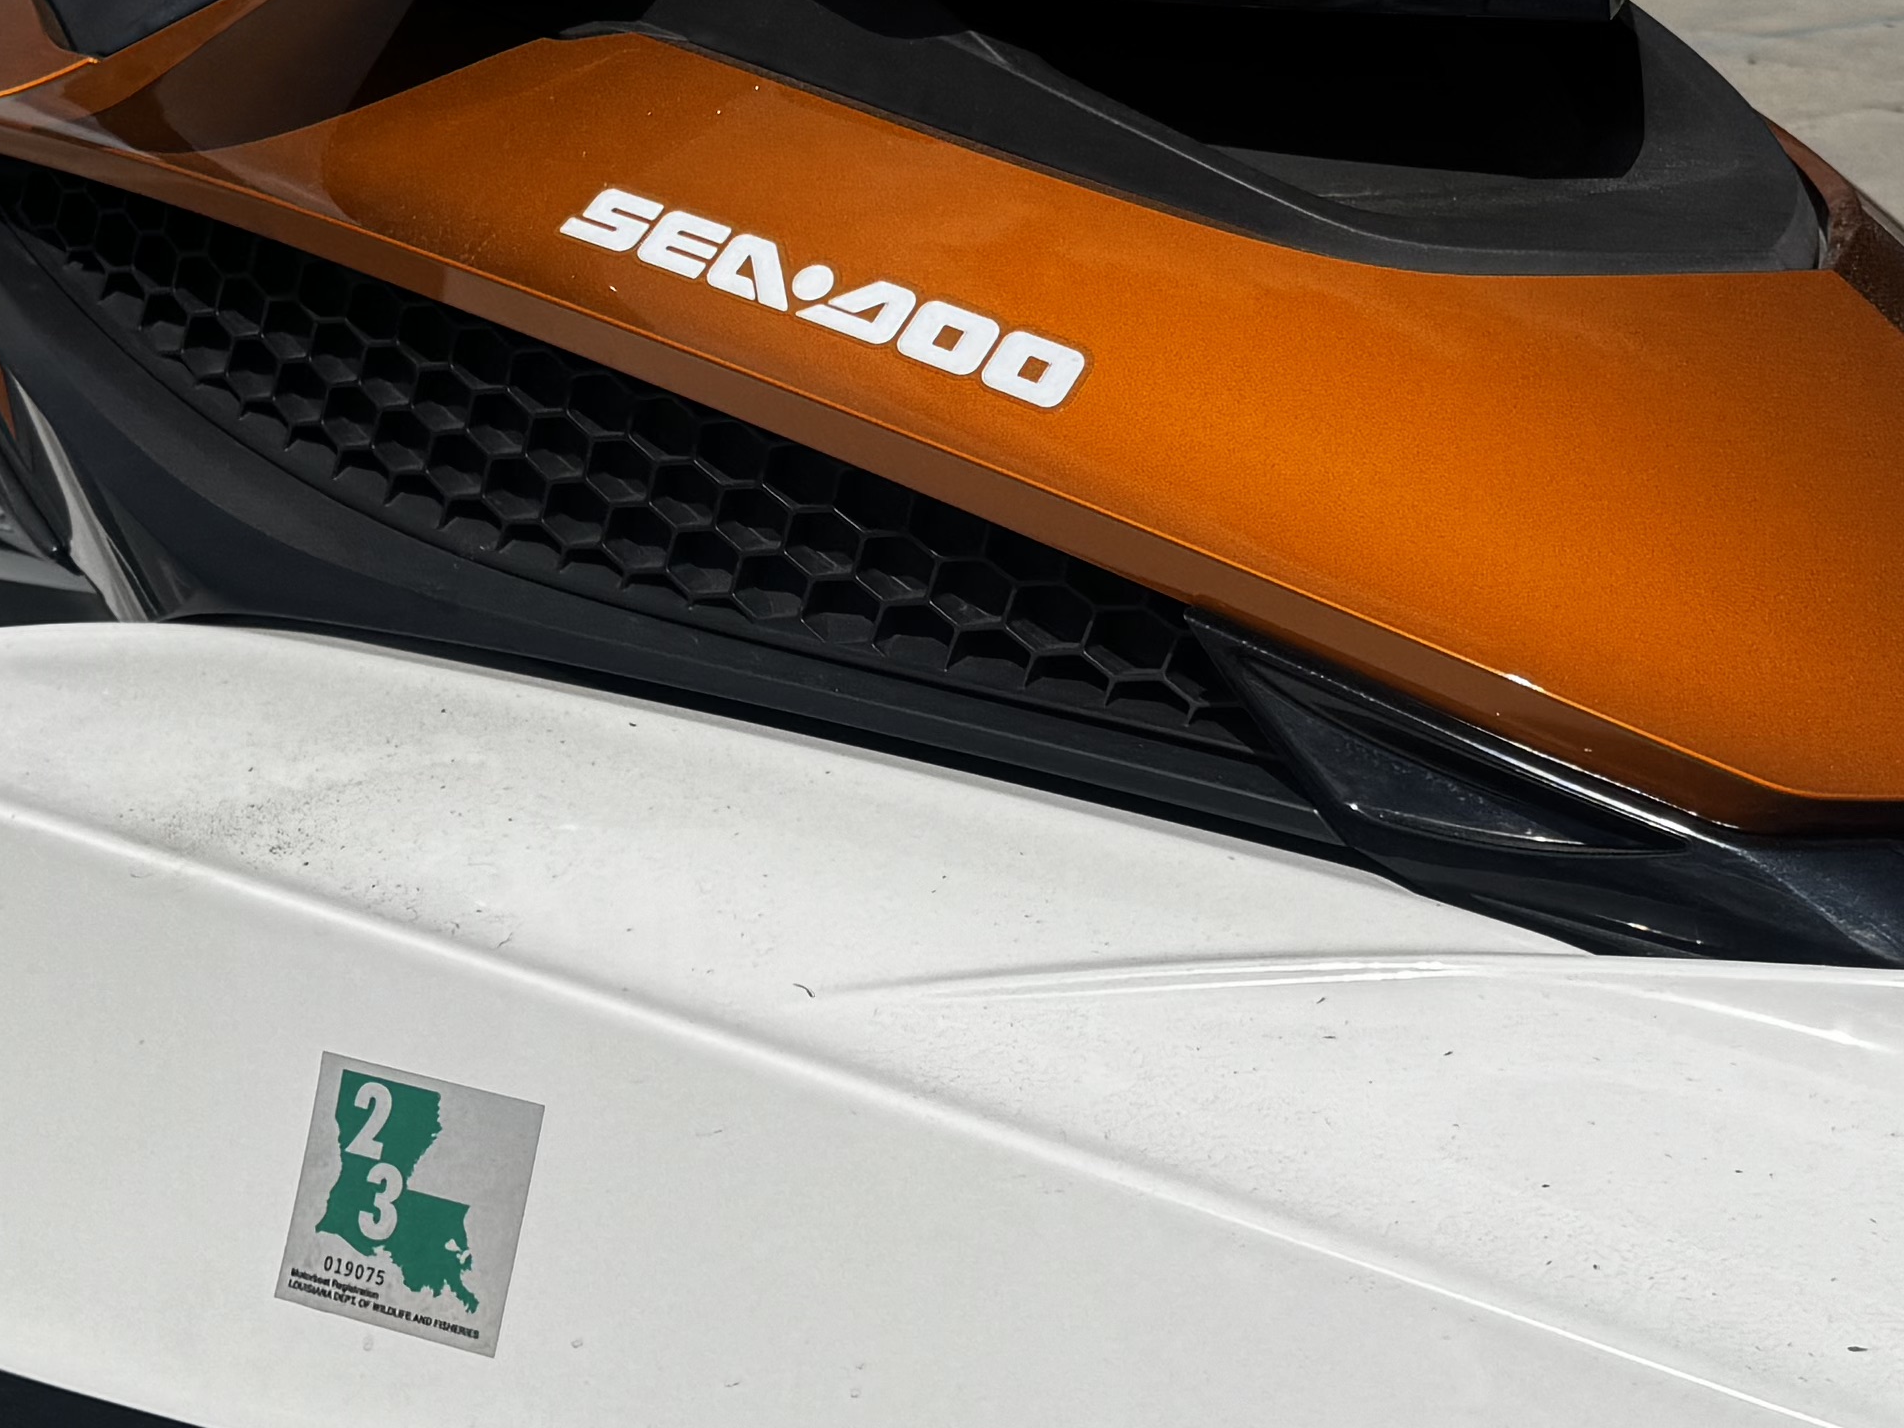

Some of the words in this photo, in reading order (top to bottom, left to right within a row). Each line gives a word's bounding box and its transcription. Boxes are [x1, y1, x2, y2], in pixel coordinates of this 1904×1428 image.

[345, 1081, 393, 1160] 2
[358, 1162, 404, 1241] 3
[323, 1255, 386, 1286] 019075
[288, 1278, 333, 1300] LOUISIANA
[358, 1298, 372, 1309] OF
[372, 1302, 412, 1321] WILDLIFE
[412, 1314, 433, 1327] AND
[433, 1318, 480, 1340] FISHERIES
